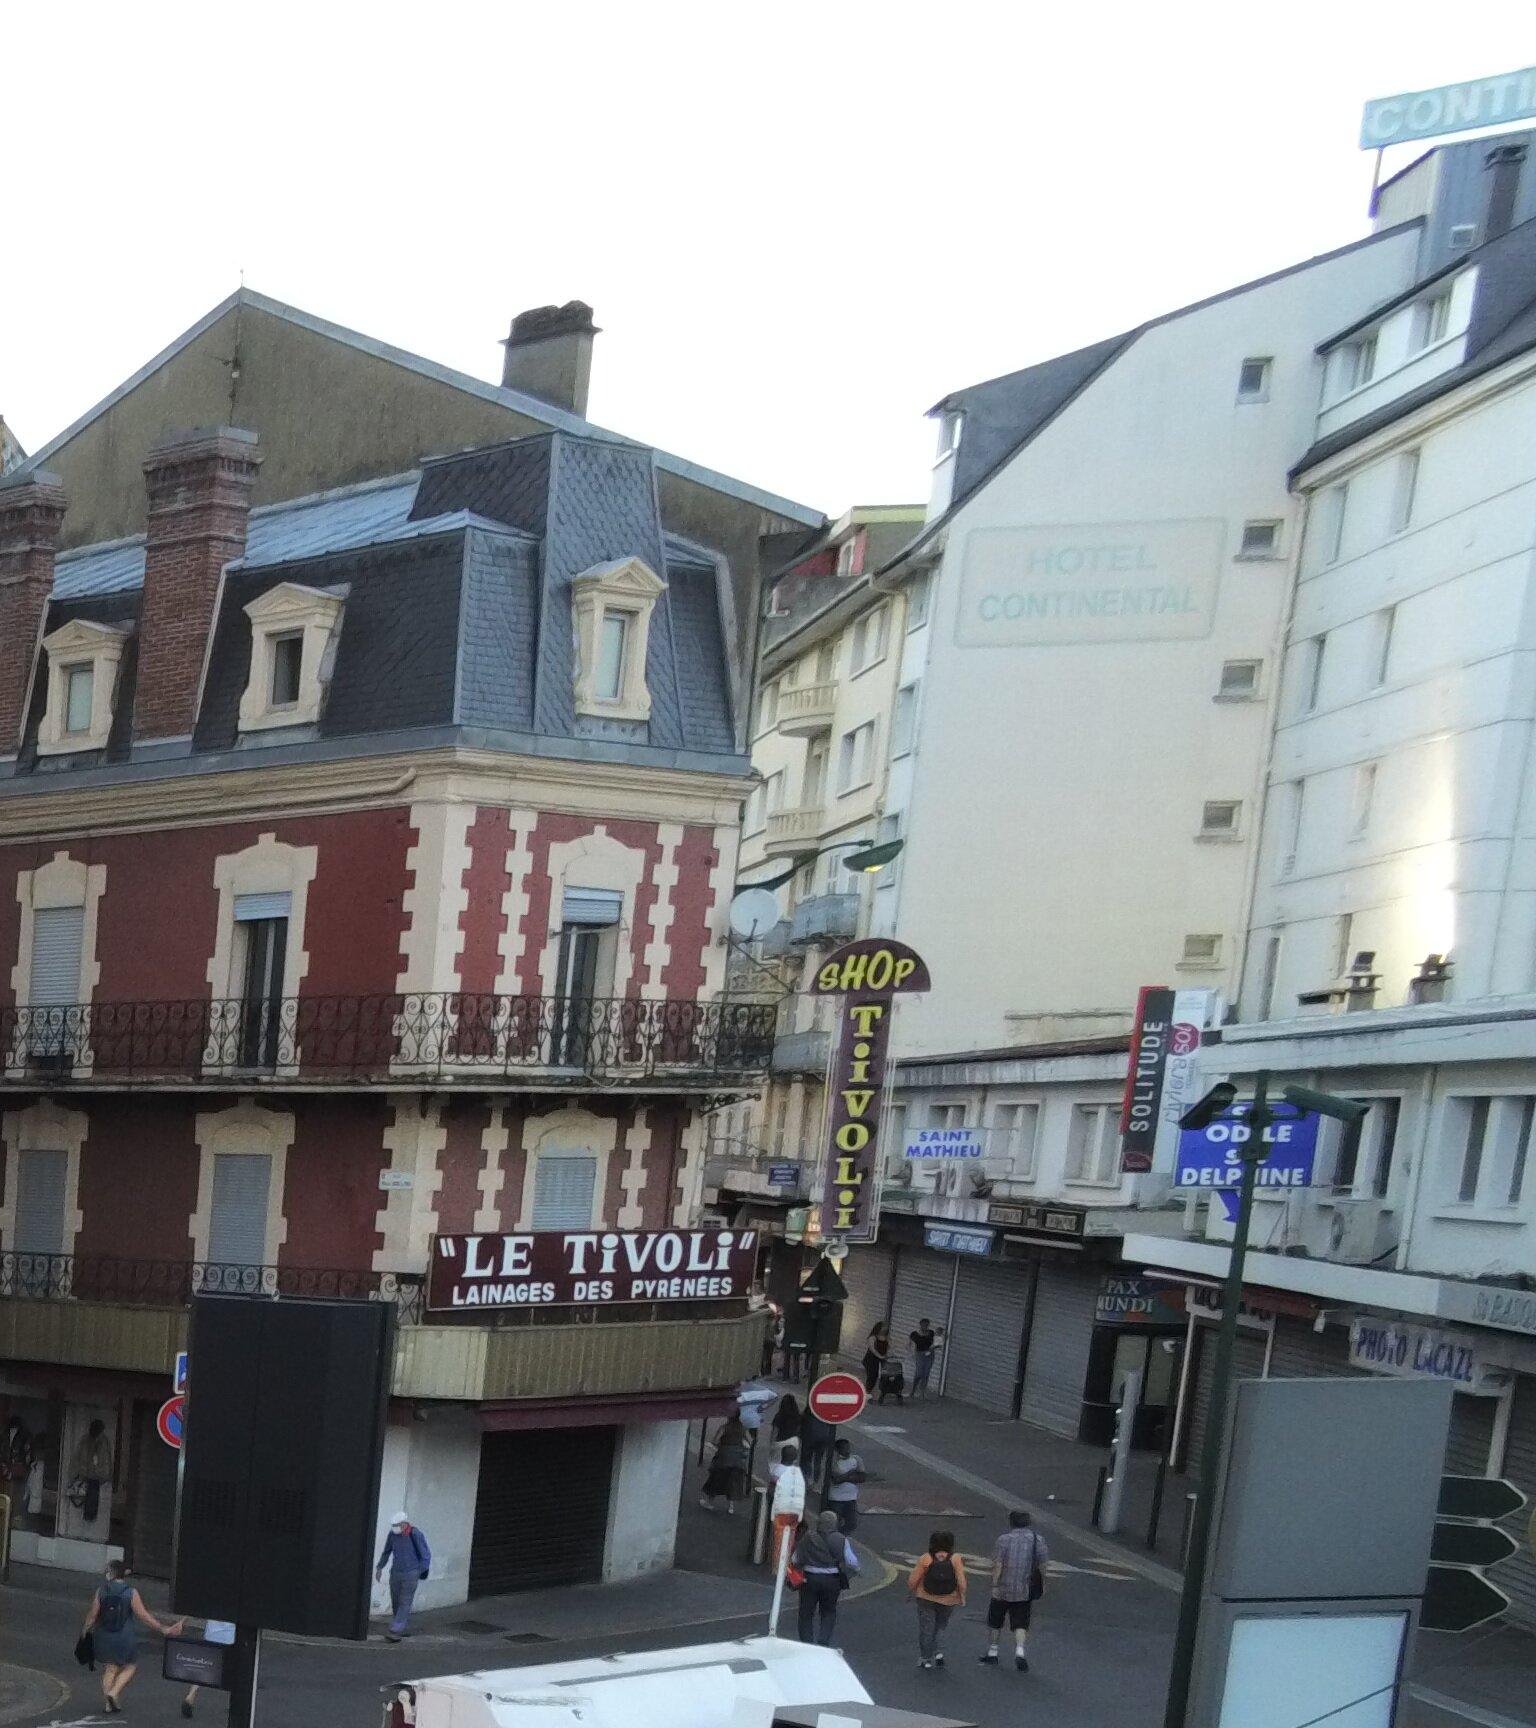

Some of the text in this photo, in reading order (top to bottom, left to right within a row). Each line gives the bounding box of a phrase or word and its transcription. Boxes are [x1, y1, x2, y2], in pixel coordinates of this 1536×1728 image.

[1367, 74, 1536, 141] CONTI
[1029, 546, 1157, 575] HOTEL
[980, 587, 1200, 622] CONTINENTAL
[819, 949, 916, 991] SHOP
[1130, 1021, 1163, 1132] SOLITUDE
[919, 1130, 973, 1142] SAINT
[1206, 1124, 1292, 1142] ODLE
[906, 1143, 981, 1158] MATHIEU
[1181, 1167, 1304, 1185] DELPINE
[452, 1282, 555, 1305] LAINAGES
[573, 1280, 613, 1301] DES
[1107, 1279, 1140, 1295] PAX
